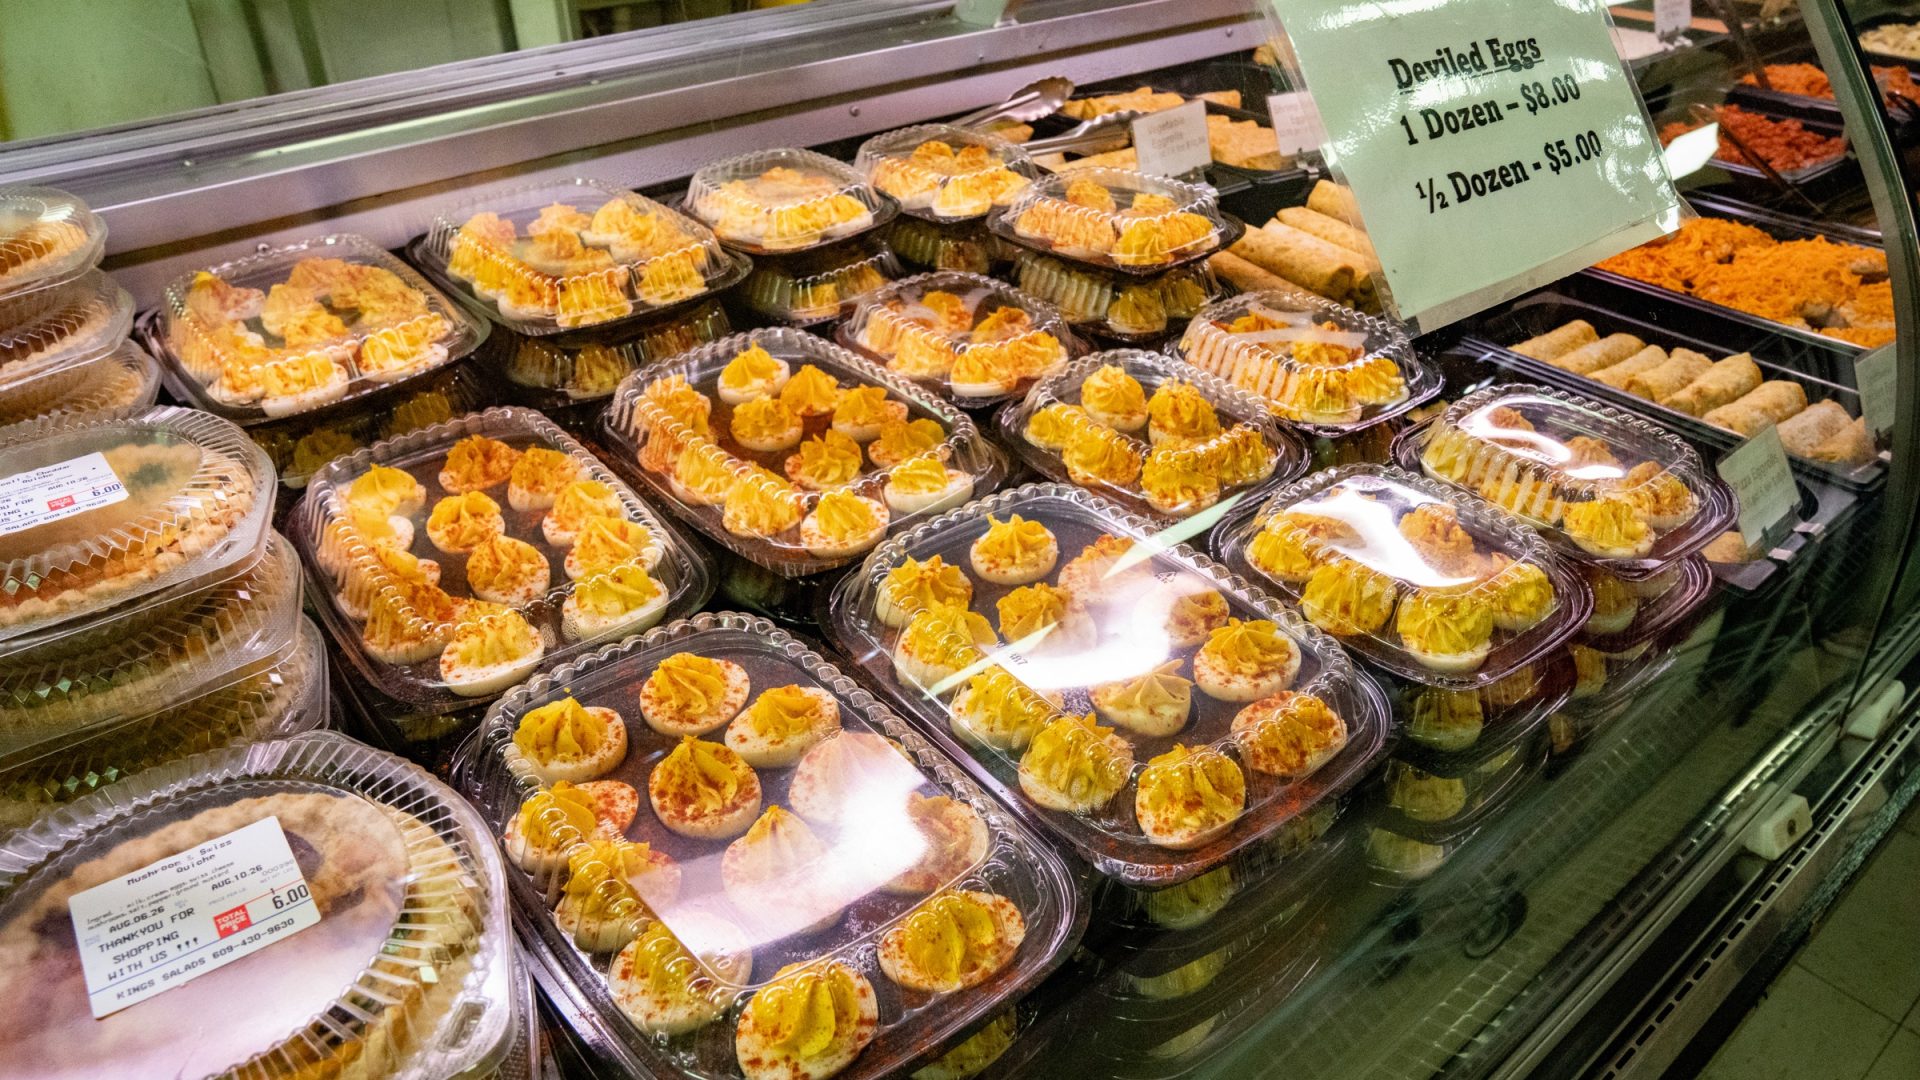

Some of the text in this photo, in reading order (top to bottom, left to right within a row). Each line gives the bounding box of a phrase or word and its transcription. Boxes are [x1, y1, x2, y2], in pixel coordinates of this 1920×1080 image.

[1388, 34, 1542, 89] Deviled Eggs
[1400, 115, 1419, 145] 1
[1419, 100, 1504, 140] Dozen
[1520, 74, 1580, 116] $8.00
[1447, 160, 1530, 203] Dozen
[1544, 130, 1602, 175] $5.00
[127, 861, 182, 885] Mushroom
[200, 840, 232, 855] Swiss
[109, 906, 165, 933] AUG.06.26
[212, 865, 263, 891] AUG.10.26
[170, 907, 195, 924] FOR
[272, 884, 309, 909] 6.00
[216, 908, 246, 925] TOTAL
[219, 915, 247, 933] PRICE
[108, 961, 143, 982] WITH
[150, 951, 168, 965] US
[113, 931, 180, 965] SHOPPING
[116, 918, 295, 1000] KINGS SALADS 609-430-9630
